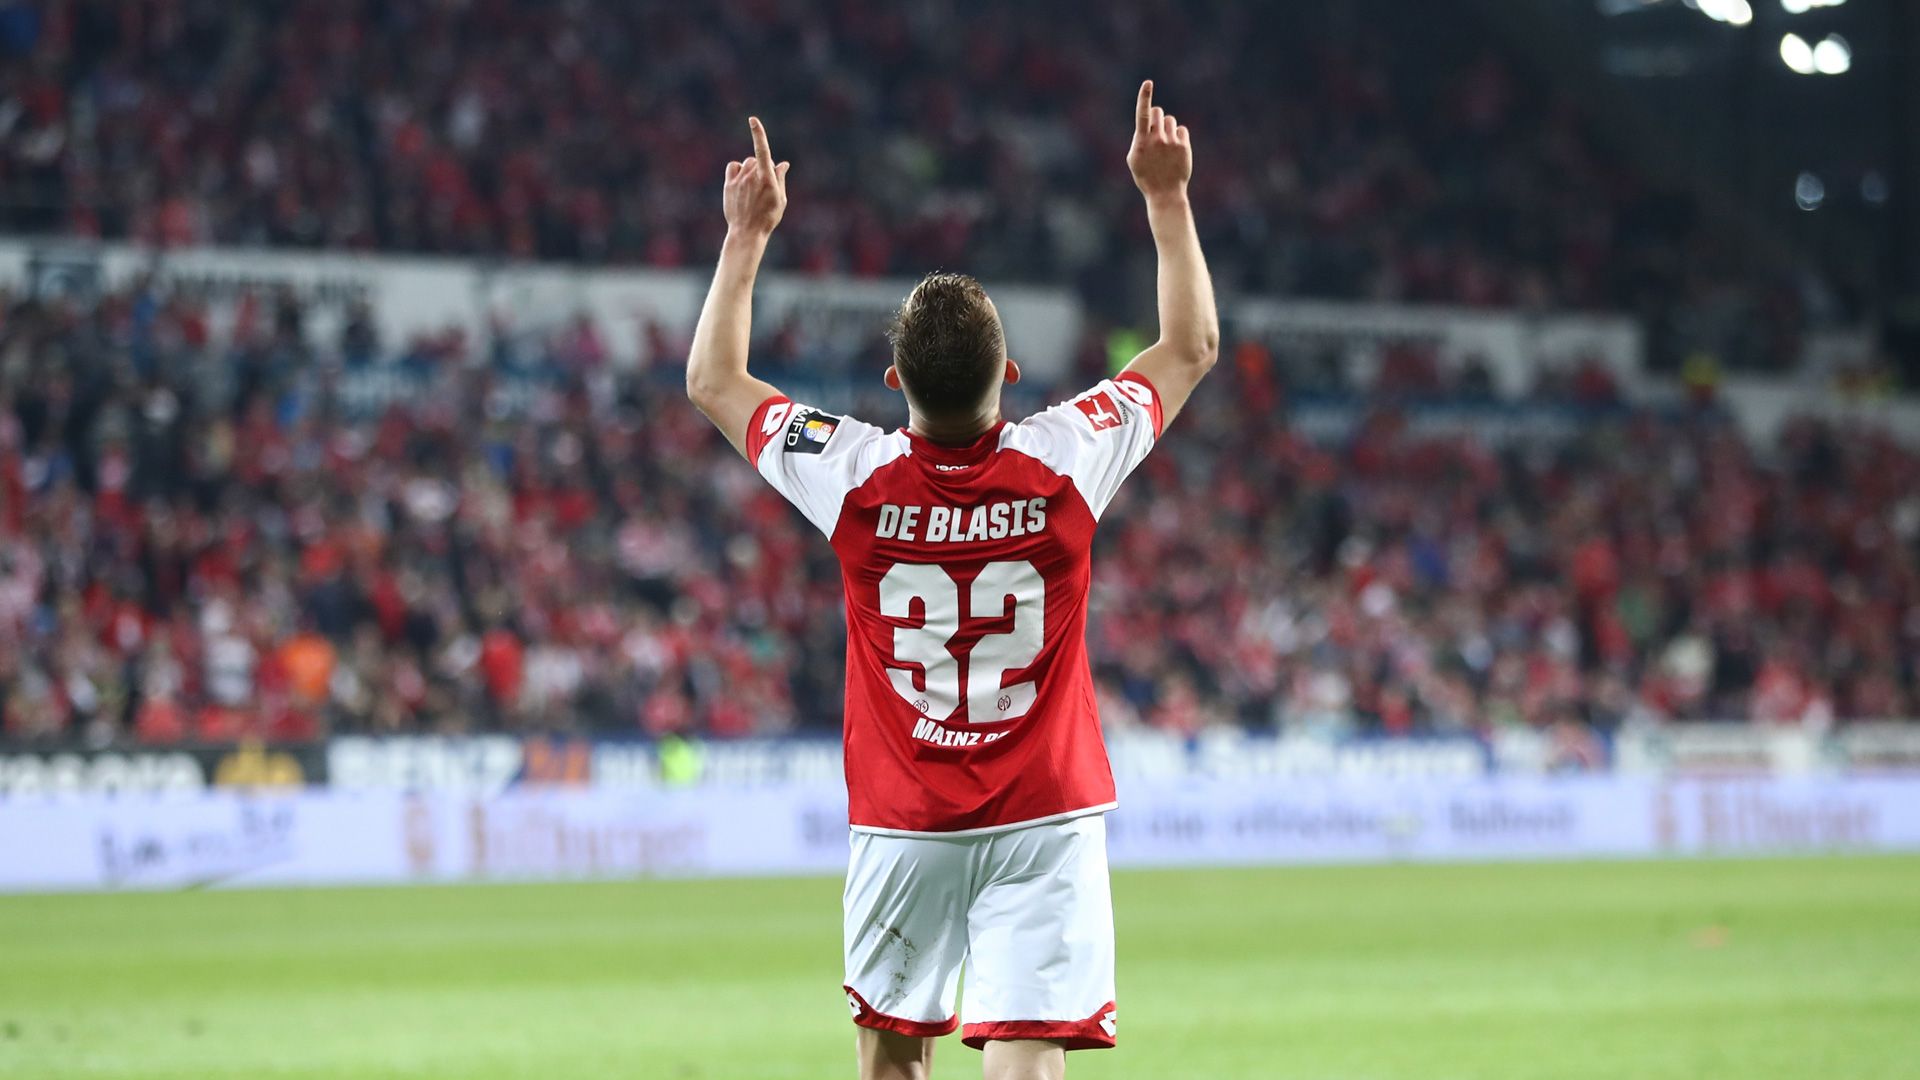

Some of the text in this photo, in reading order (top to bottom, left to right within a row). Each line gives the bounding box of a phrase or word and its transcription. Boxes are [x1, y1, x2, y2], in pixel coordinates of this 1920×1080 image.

[787, 410, 808, 446] MFD
[875, 497, 1047, 542] DE BLASIS
[879, 560, 1046, 723] 32
[912, 717, 981, 746] MAINZ
